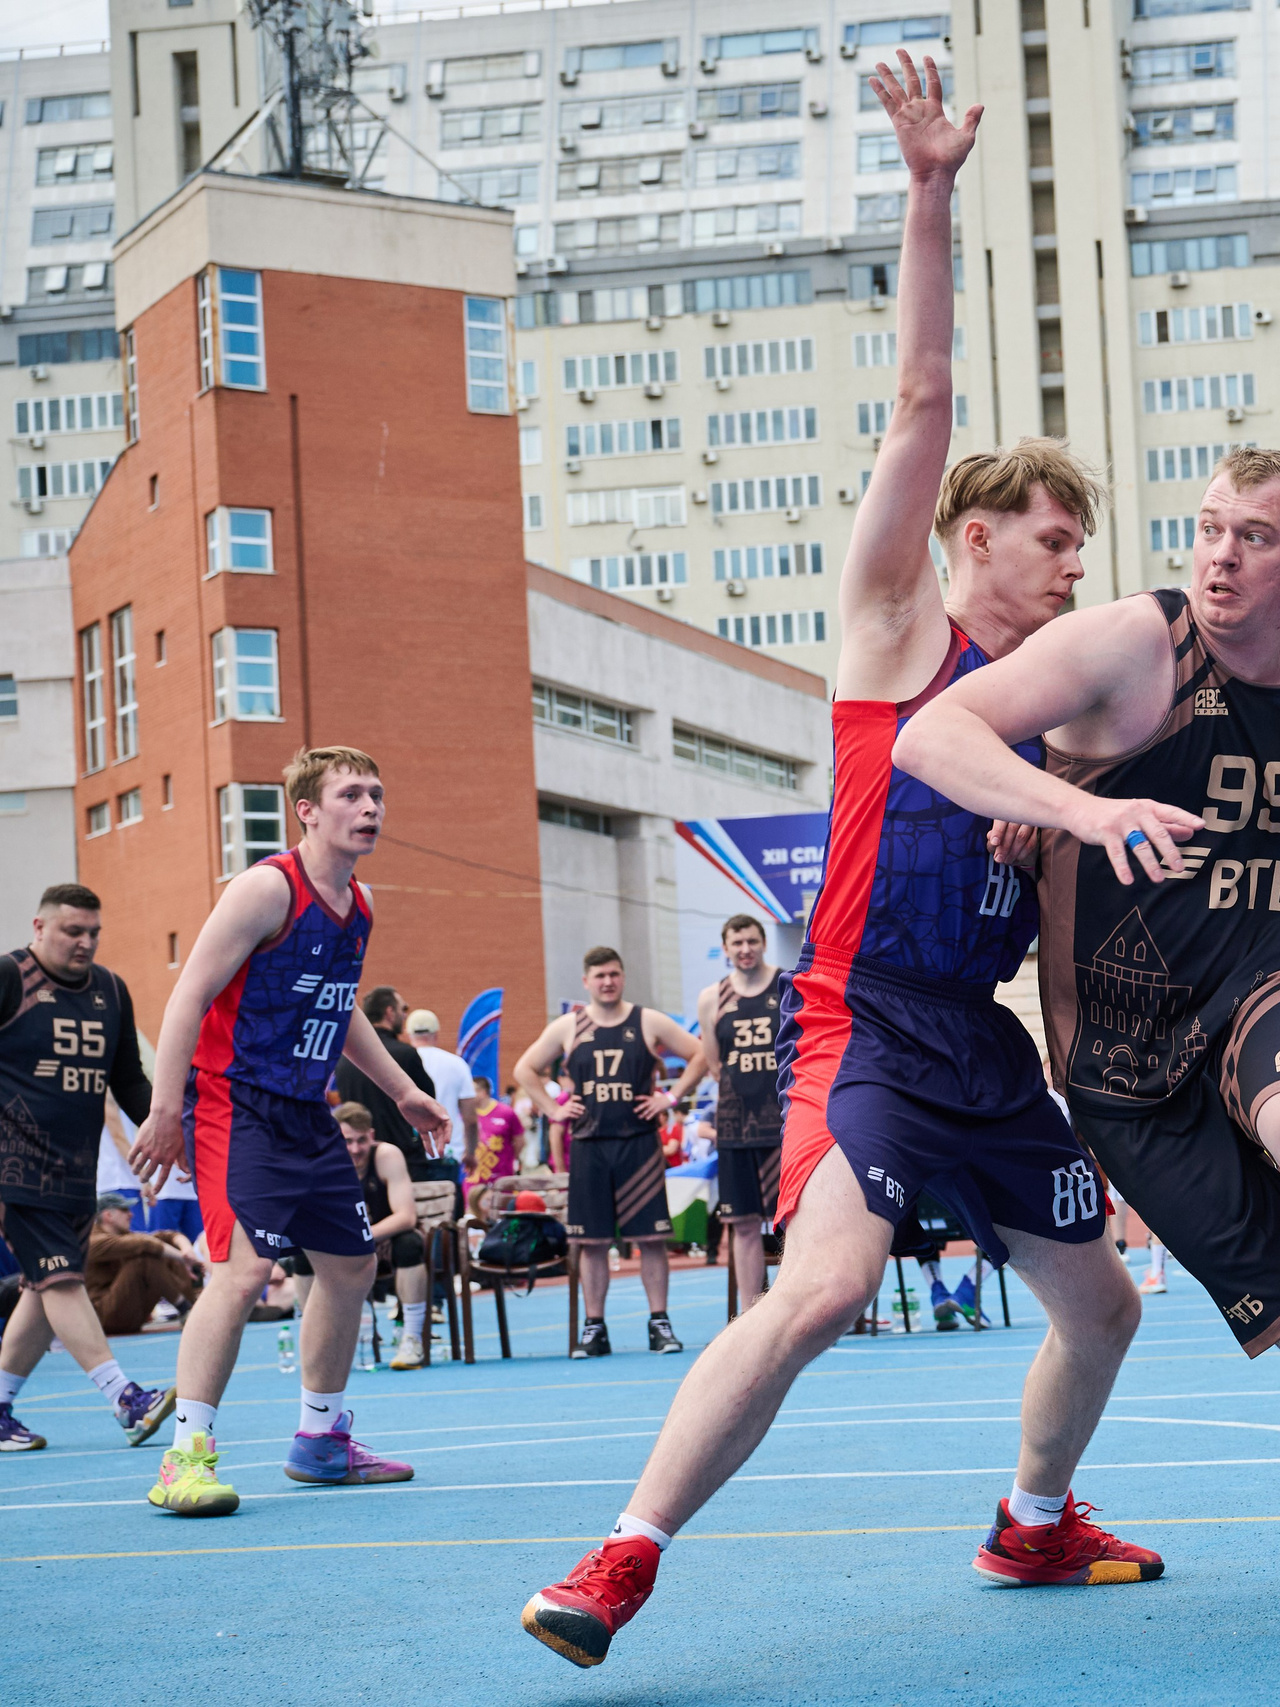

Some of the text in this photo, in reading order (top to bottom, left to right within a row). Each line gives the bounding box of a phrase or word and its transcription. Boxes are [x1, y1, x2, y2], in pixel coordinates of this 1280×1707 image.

[1195, 689, 1226, 708] ABC
[315, 982, 360, 1012] ВТБ
[53, 1018, 106, 1058] 55
[293, 1018, 339, 1061] 30
[733, 1016, 772, 1047] 33
[593, 1049, 624, 1077] 17
[740, 1051, 778, 1073] ВТБ
[63, 1066, 106, 1094] ВТБ
[596, 1082, 634, 1102] ВТБ
[886, 1176, 905, 1208] ВТБ
[1051, 1159, 1098, 1227] 88
[47, 1255, 69, 1271] ВТБ
[1230, 1293, 1264, 1325] ВТБ
